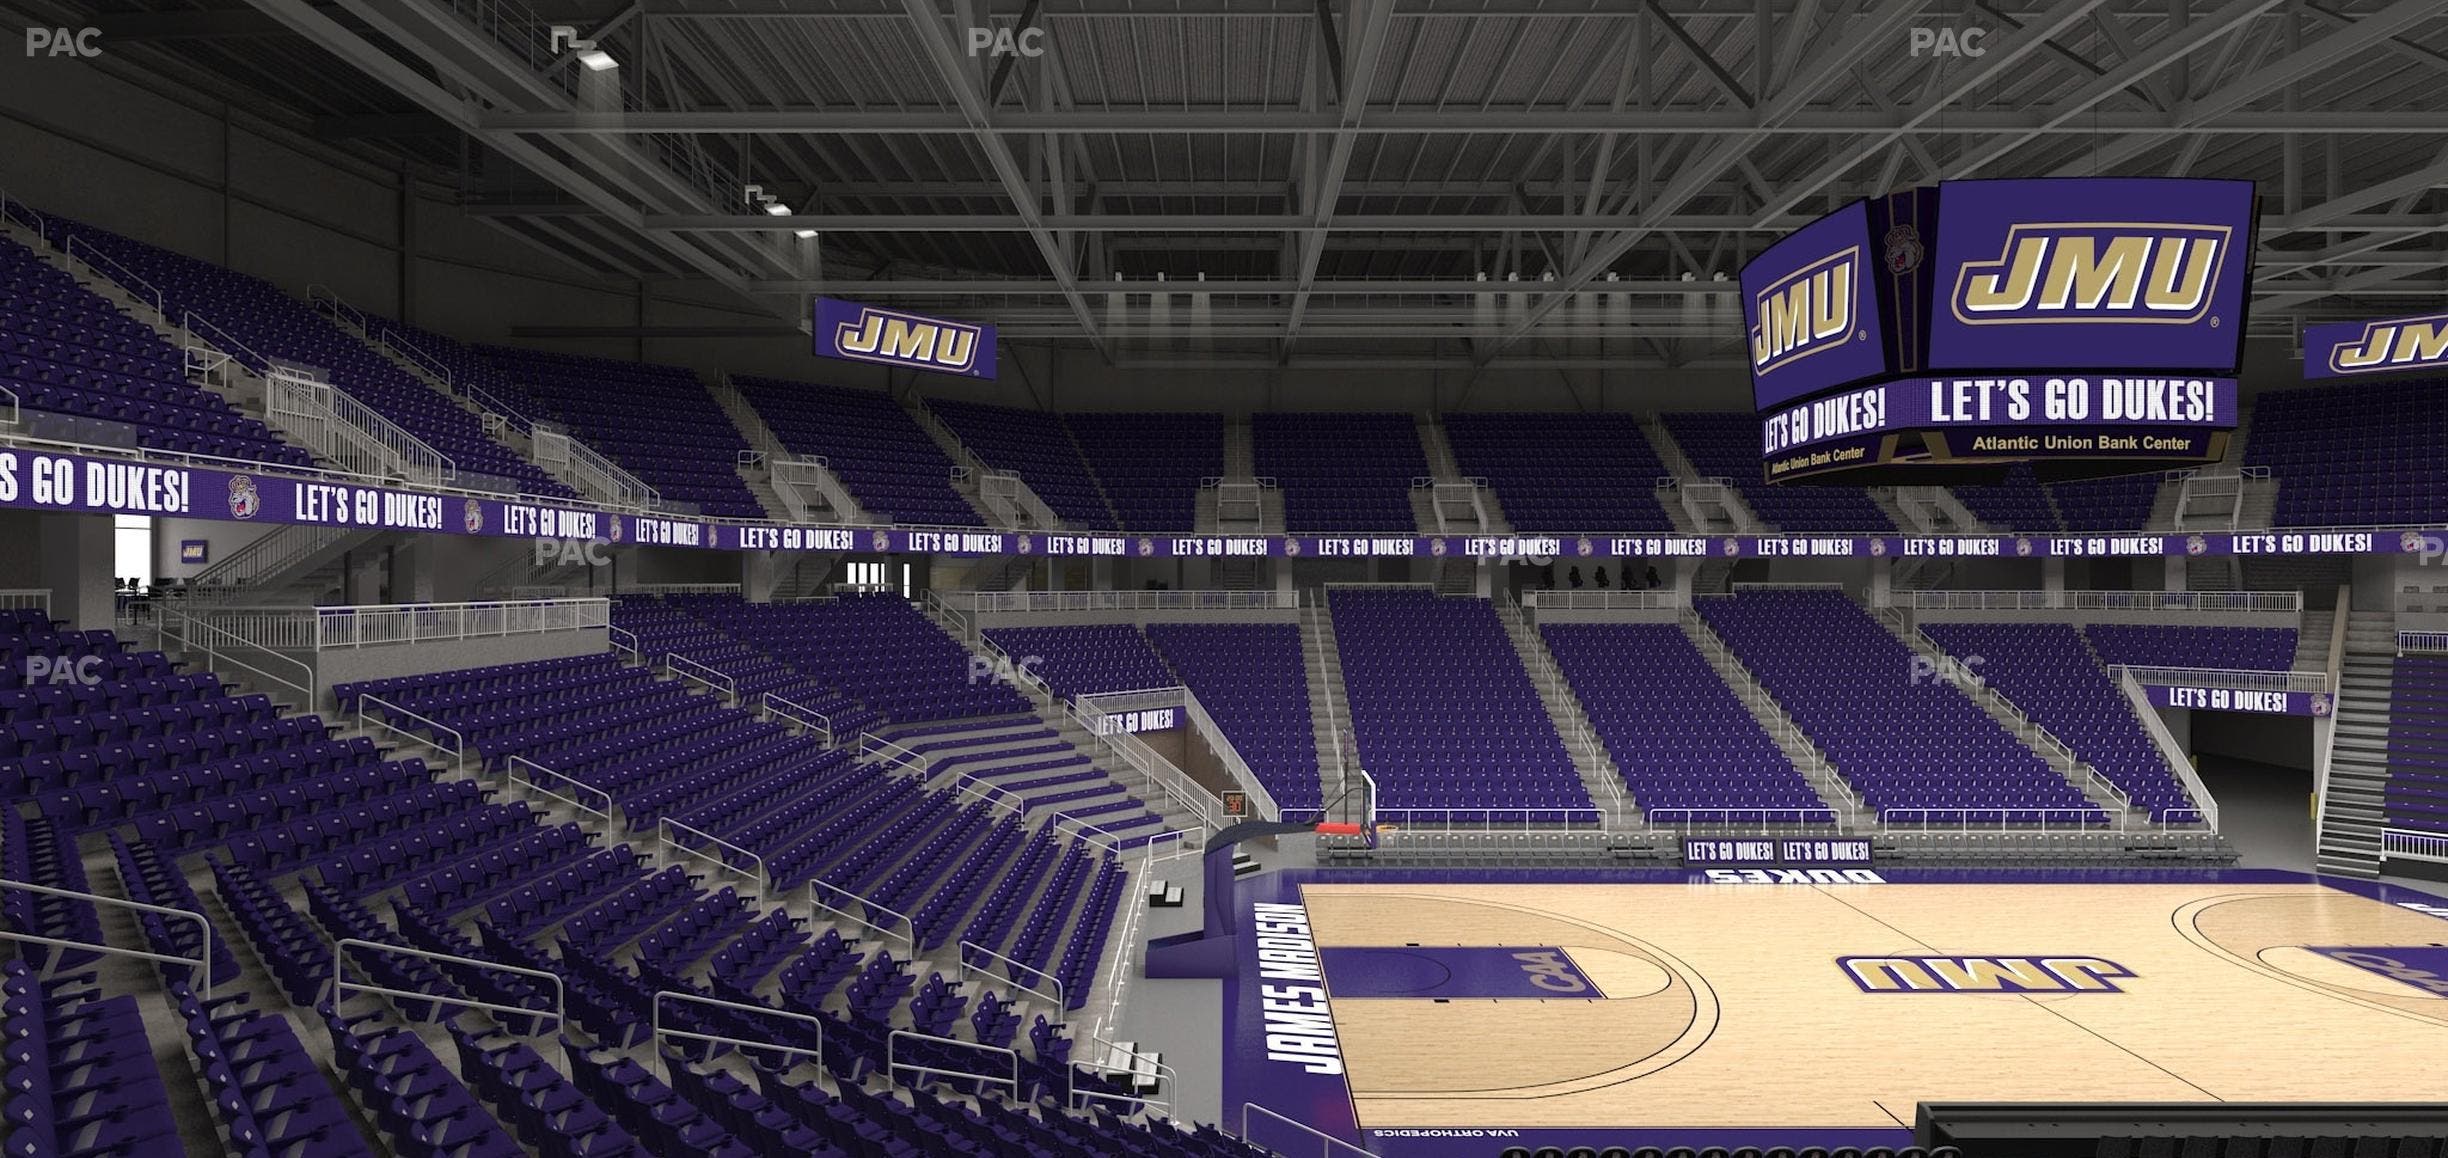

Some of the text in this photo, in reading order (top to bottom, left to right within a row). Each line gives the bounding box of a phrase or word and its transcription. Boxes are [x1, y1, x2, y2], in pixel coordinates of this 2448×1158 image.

[1963, 235, 2218, 312] JMU
[1754, 261, 1850, 366] JMU
[842, 316, 974, 366] JMU
[1932, 379, 2213, 421] LET'S GO DUKES!
[1765, 388, 1886, 454] LET'S GO DUKES!
[1973, 435, 2191, 450] Atlantic Union Bank Center
[1790, 456, 1810, 470] Union
[1811, 451, 1832, 466] Bank
[1833, 447, 1865, 461] Center
[33, 456, 74, 505] GO
[86, 461, 189, 512] DUKES!
[296, 483, 442, 529] LET'S GO DUKES!
[504, 505, 596, 539] LET'S GO DUKES!
[636, 518, 699, 545] LET'S GO DUKES!
[740, 528, 854, 550] LET'S GO DUKES!
[909, 532, 1002, 553] LET'S GO DUKES!
[1048, 536, 1126, 556] LET'S GO DUKES!
[1173, 538, 1268, 556] LET'S GO DUKES!
[1319, 538, 1414, 556] LET'S GO DUKES!
[1465, 538, 1561, 556] LET'S GO DUKES!
[1612, 538, 1707, 556] LET'S GO DUKES!
[1758, 538, 1853, 556] LET'S GO DUKES!
[1904, 538, 2000, 556] LET'S GO DUKES!
[2051, 538, 2164, 556] LET'S GO DUKES!
[2232, 534, 2372, 553] LET'S GO DUKES!
[2170, 687, 2287, 712] LET'S GO DUKES!
[1126, 712, 1139, 732] GO
[1141, 708, 1174, 731] DUKES!
[1688, 842, 1774, 861] LET'S GO DUKES!
[1784, 842, 1869, 861] LET'S GO DUKES!
[1704, 869, 1888, 884] DUKES
[1511, 951, 1587, 993] CAA
[1844, 957, 2126, 991] JMU
[1254, 902, 1343, 1075] JAMES MADISON
[1374, 1129, 1519, 1137] UVA ORTHOPEDICS
